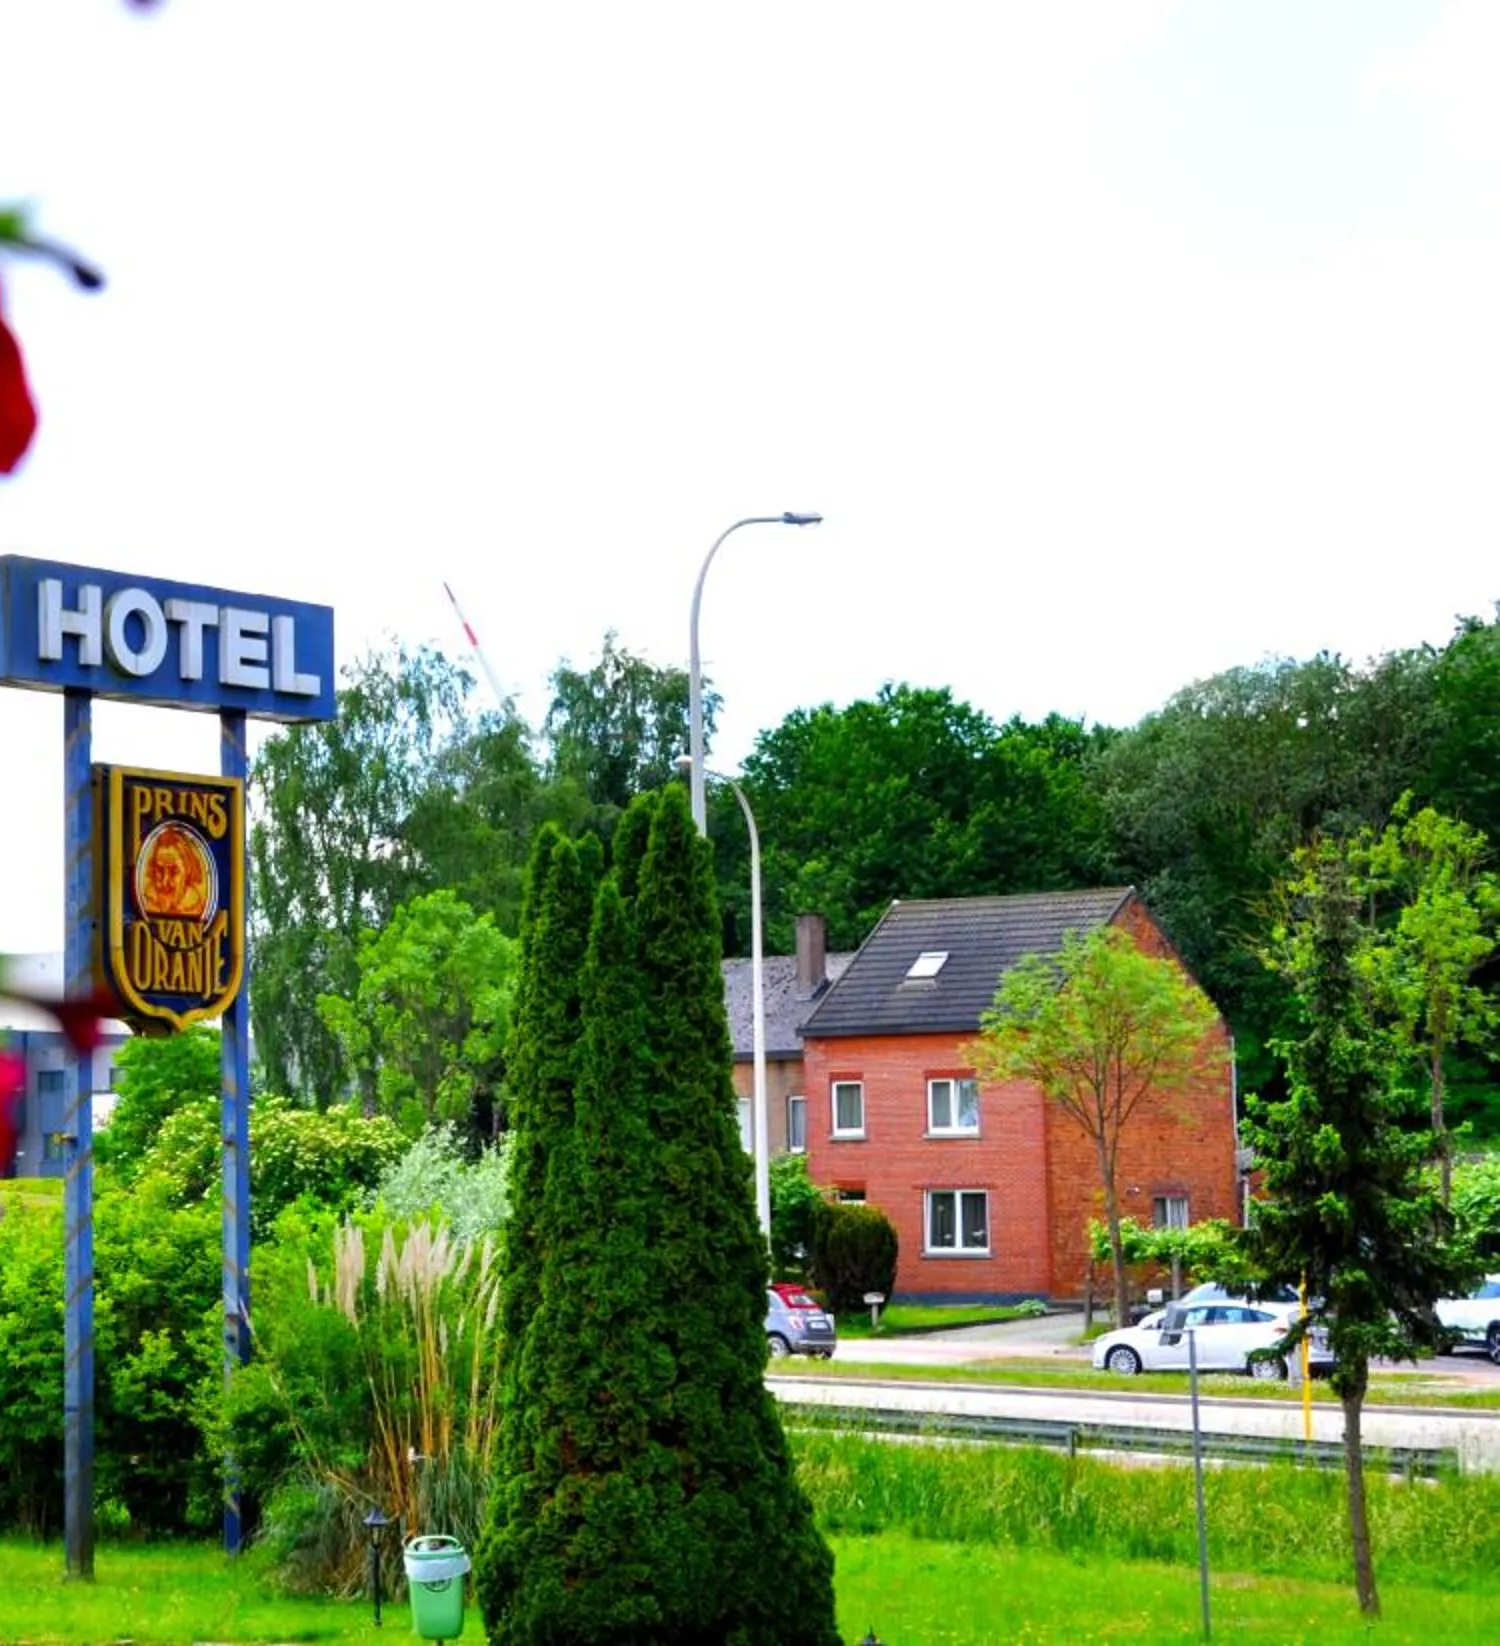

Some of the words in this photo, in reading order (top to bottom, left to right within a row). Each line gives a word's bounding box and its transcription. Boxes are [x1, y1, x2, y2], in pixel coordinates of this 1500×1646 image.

[38, 578, 321, 697] HOTEL
[132, 785, 227, 858] PRINS
[133, 909, 229, 999] ORANJE
[155, 919, 204, 949] VAN
